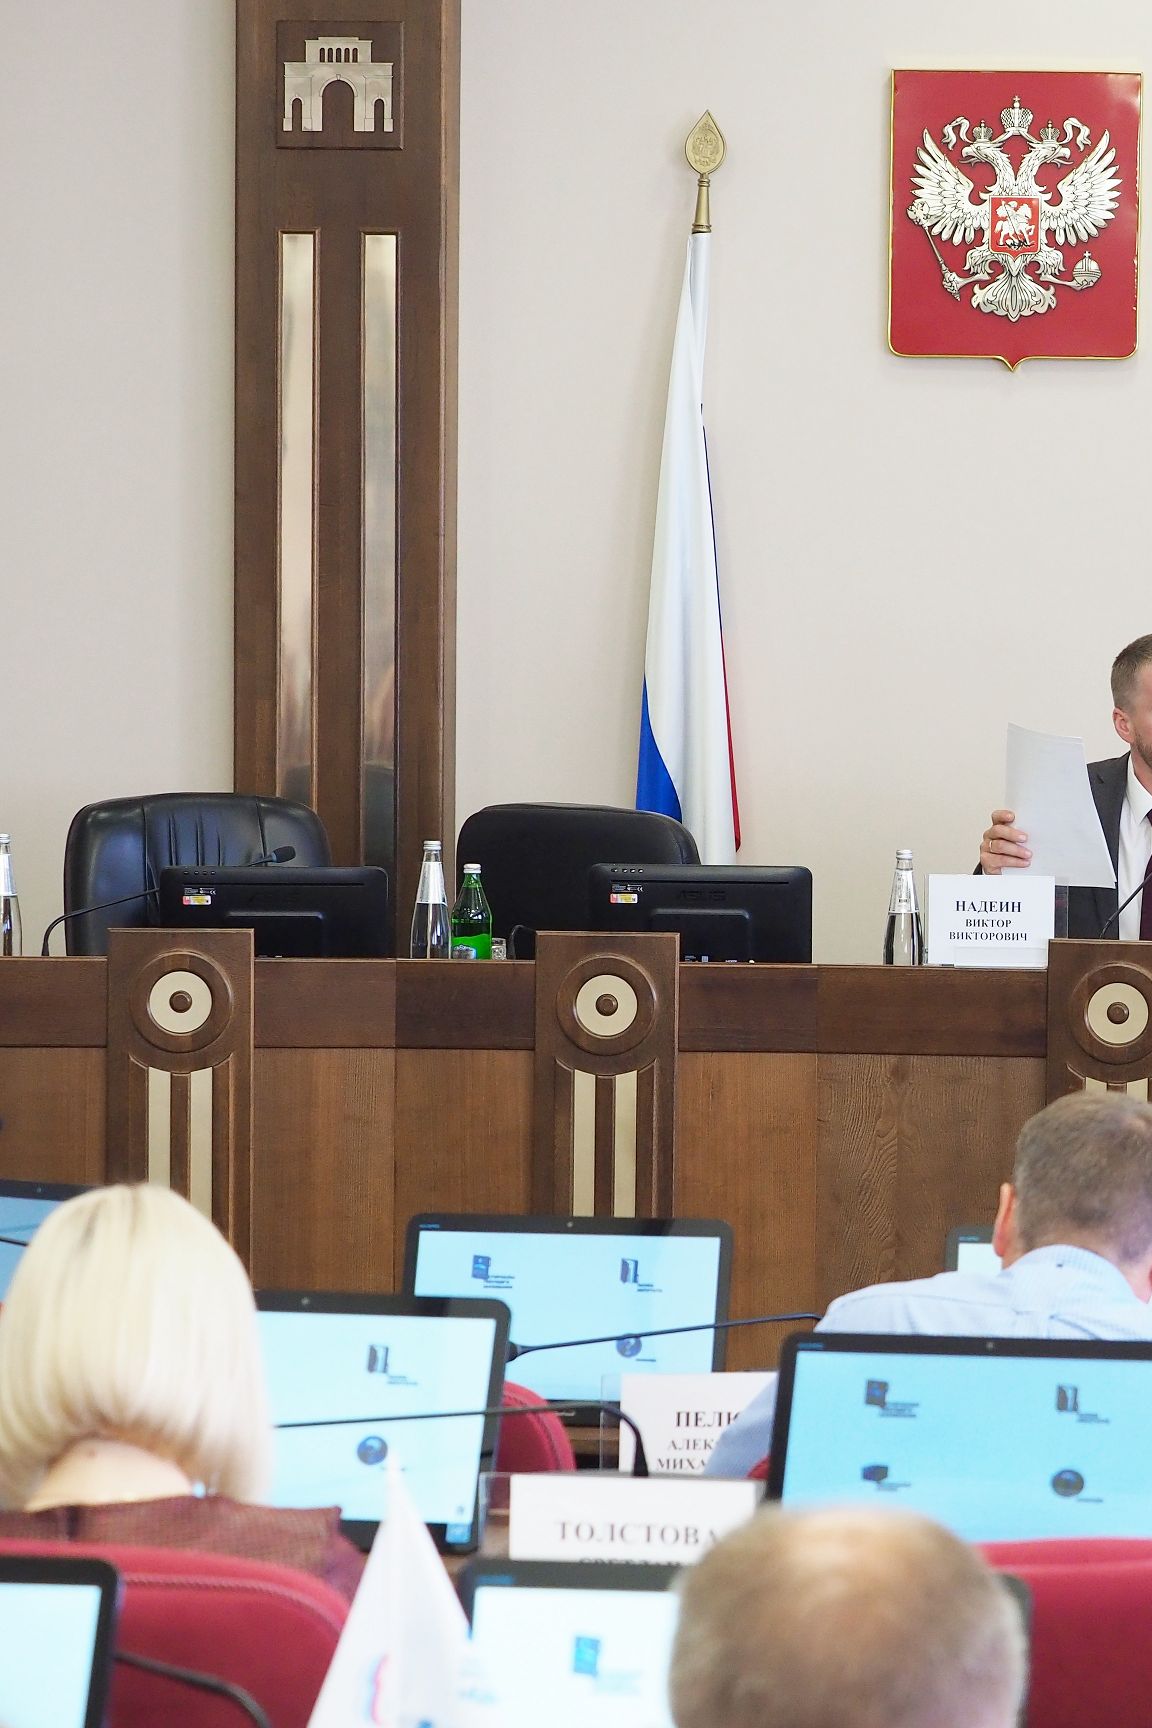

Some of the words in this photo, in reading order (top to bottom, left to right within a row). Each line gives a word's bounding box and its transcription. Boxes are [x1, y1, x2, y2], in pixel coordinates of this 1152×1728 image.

[955, 900, 1022, 913] НАДЕИН
[965, 918, 1012, 928] ВИКТОР
[949, 931, 1028, 941] ВИКТОРОВИЧ
[667, 1438, 714, 1451] АЛЕК
